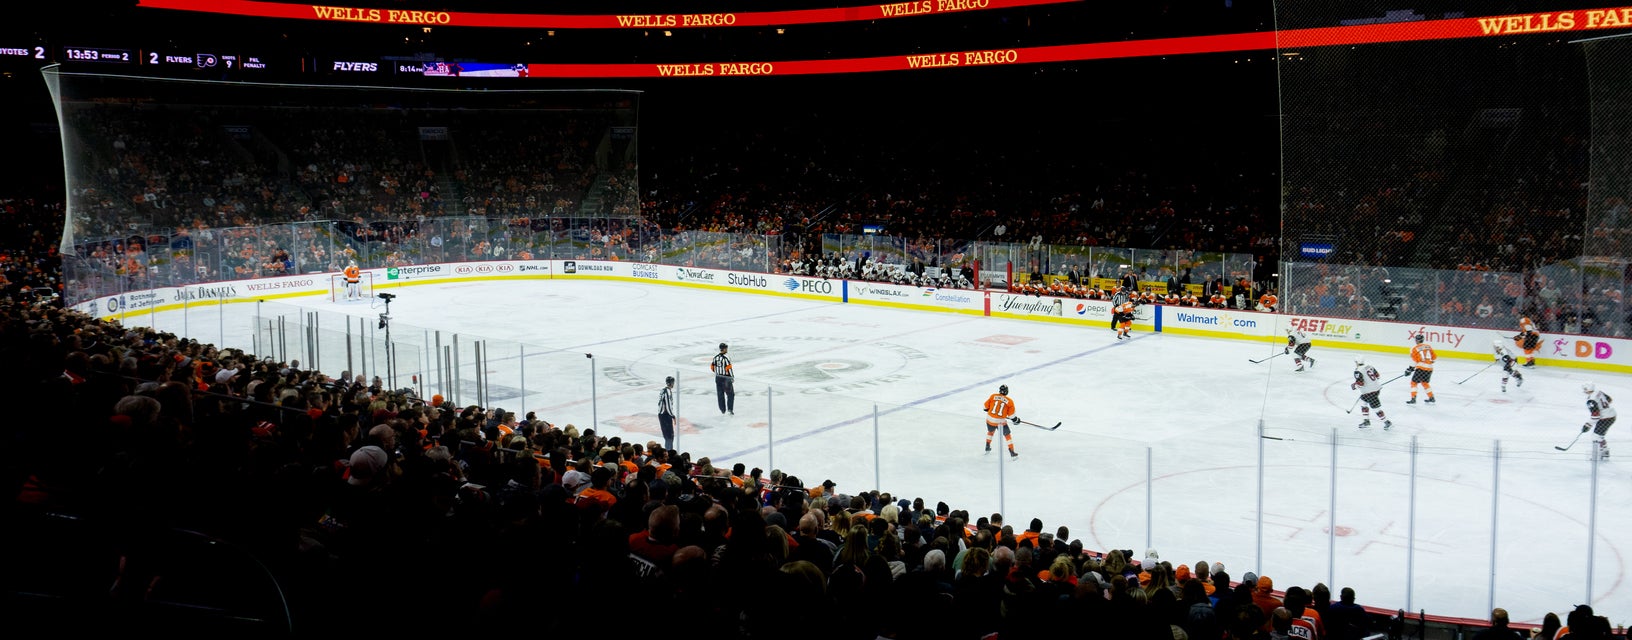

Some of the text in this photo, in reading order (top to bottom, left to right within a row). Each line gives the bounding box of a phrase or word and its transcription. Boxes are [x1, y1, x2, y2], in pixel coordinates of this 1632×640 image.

[312, 5, 450, 24] WELLS FARGO
[880, 0, 988, 17] WELLS FARGO
[617, 13, 736, 27] WELLS FARGO
[1478, 12, 1576, 35] WELLS
[35, 46, 45, 59] 2
[67, 49, 99, 60] 13:53
[122, 52, 129, 61] 2
[150, 52, 192, 64] 2 FLYERS
[907, 49, 1018, 68] WELLS FARGO
[226, 60, 233, 68] 9
[333, 61, 378, 72] FLYERS
[657, 62, 773, 77] WELLS FARGO
[478, 265, 492, 273] KIA
[632, 263, 658, 271] COMCAST
[632, 270, 658, 279] BUSINESS
[685, 268, 714, 280] NovaCare
[727, 272, 767, 288] StubHub
[247, 279, 314, 291] WELLS FARGO
[802, 280, 832, 294] PECO
[935, 293, 971, 303] Constellation
[998, 294, 1053, 314] Yuengling
[1087, 304, 1107, 313] pepsi
[1177, 312, 1218, 325] Walmart
[1408, 327, 1465, 348] xfinity
[1420, 350, 1433, 361] 14
[991, 400, 1006, 416] 11
